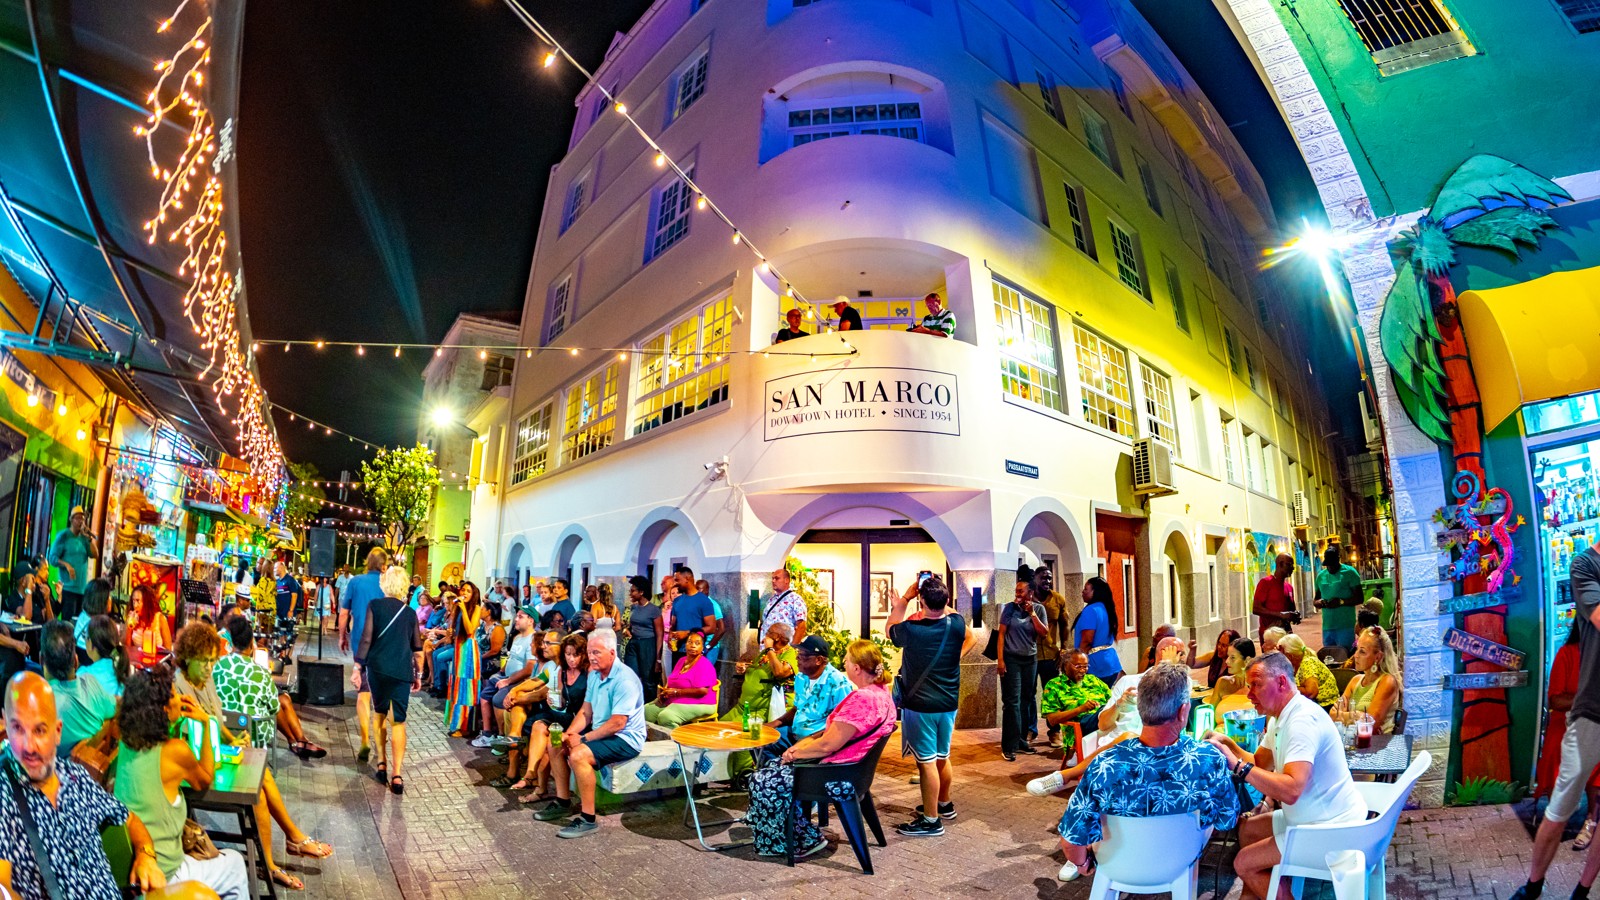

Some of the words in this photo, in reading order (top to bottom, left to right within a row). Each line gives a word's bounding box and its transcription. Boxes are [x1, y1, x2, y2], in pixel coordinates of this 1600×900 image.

[771, 383, 824, 413] SAN
[842, 380, 951, 407] MARCO
[770, 410, 831, 428] DOWNTOWN
[835, 408, 875, 419] HOTEL
[893, 408, 927, 419] SINCE
[930, 410, 952, 422] 1954
[1448, 630, 1485, 656] DUTCH
[1487, 645, 1521, 668] CHEESE
